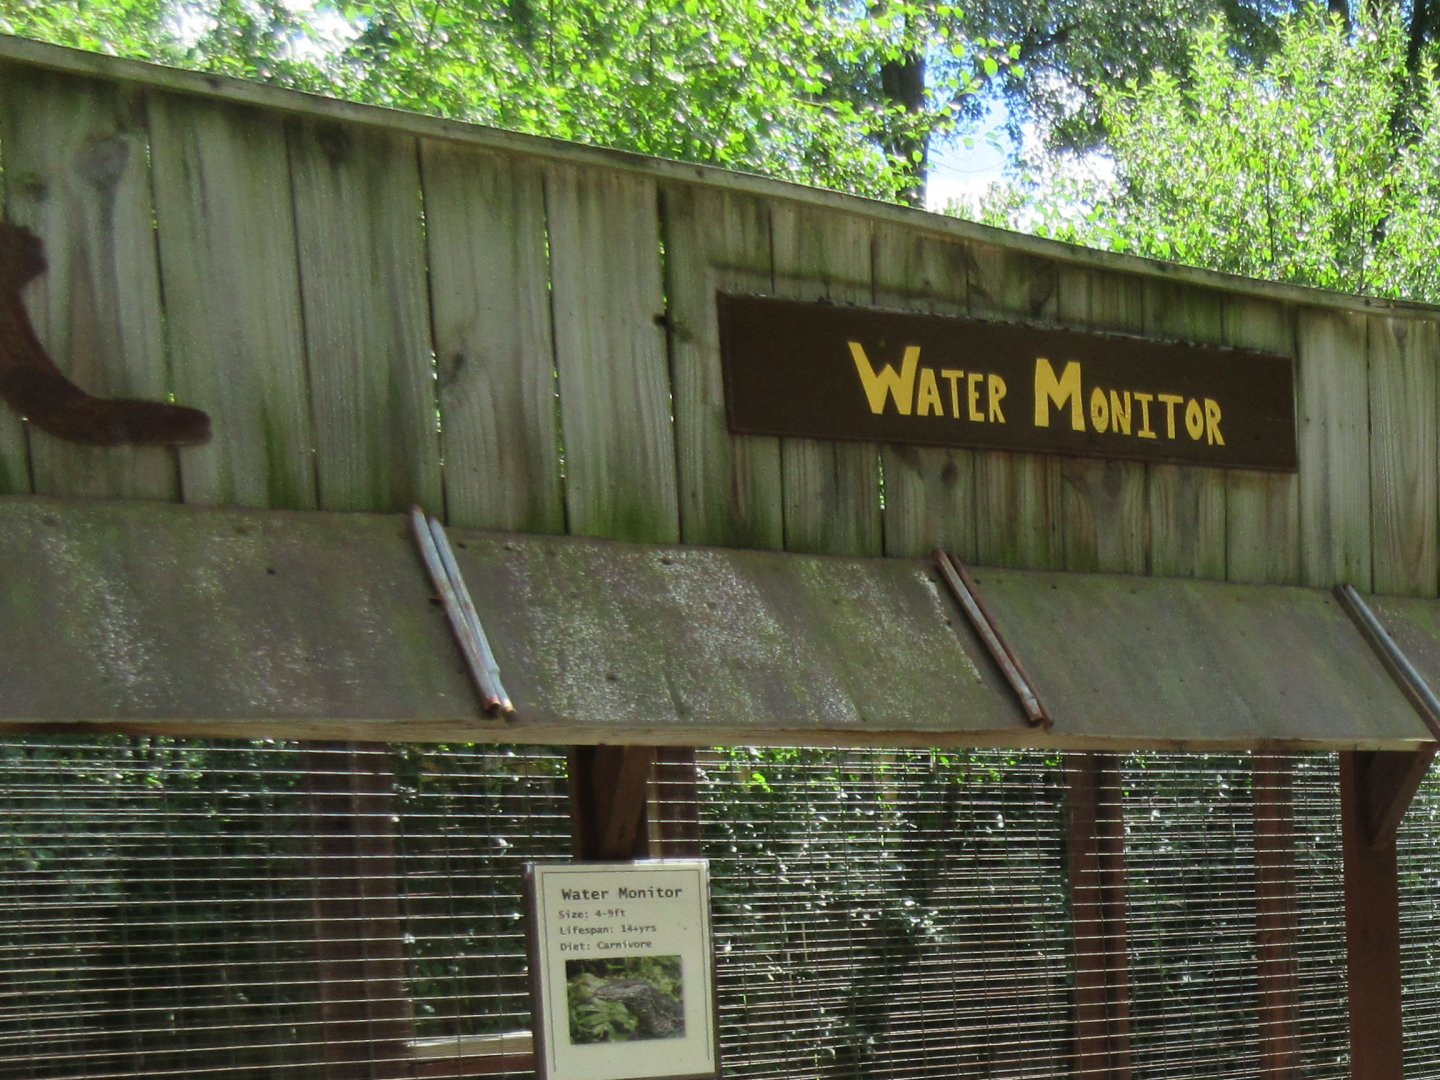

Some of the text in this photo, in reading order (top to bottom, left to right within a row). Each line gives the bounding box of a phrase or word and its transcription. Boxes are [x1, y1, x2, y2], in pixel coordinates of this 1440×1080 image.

[847, 341, 1226, 446] WATER MONITOR
[561, 886, 682, 900] Water Monitor
[558, 909, 626, 919] Size: 4-9ft
[560, 924, 657, 935] Lifespan: 14+yrs
[560, 940, 652, 951] Diet: Carnivore
